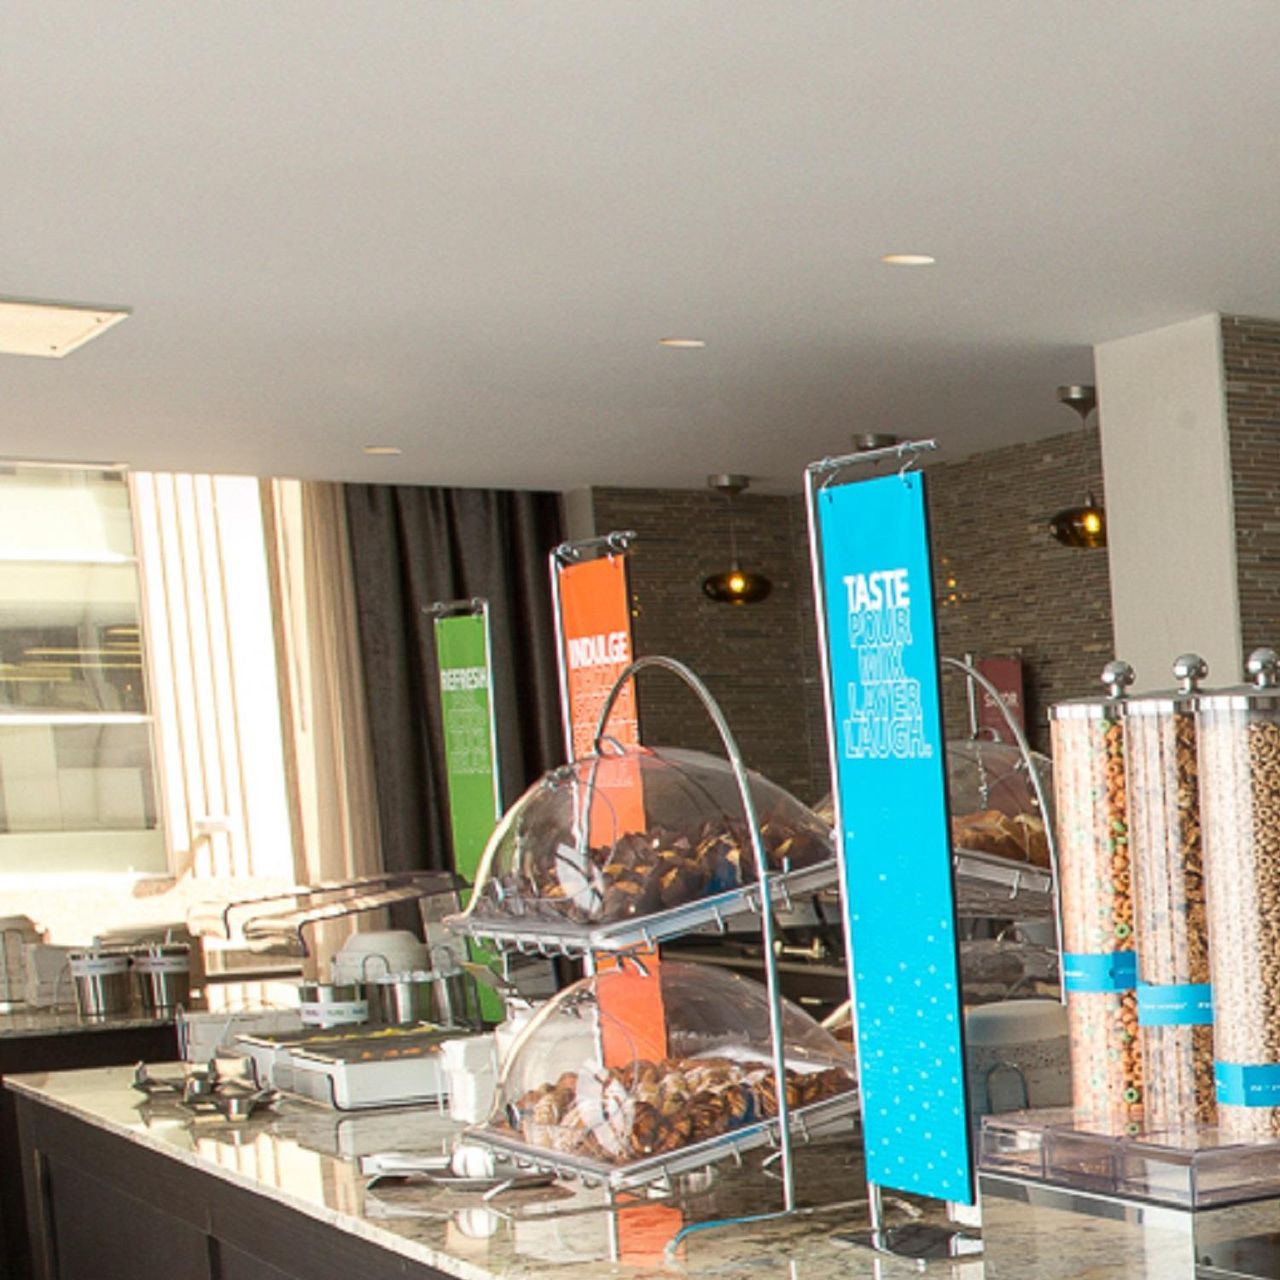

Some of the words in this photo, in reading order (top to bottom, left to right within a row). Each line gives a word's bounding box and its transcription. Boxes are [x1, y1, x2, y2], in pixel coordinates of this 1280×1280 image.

[843, 567, 910, 613] TASTE
[849, 607, 912, 649] POUR
[567, 630, 629, 670] INDULGE
[848, 680, 923, 722] LAYER
